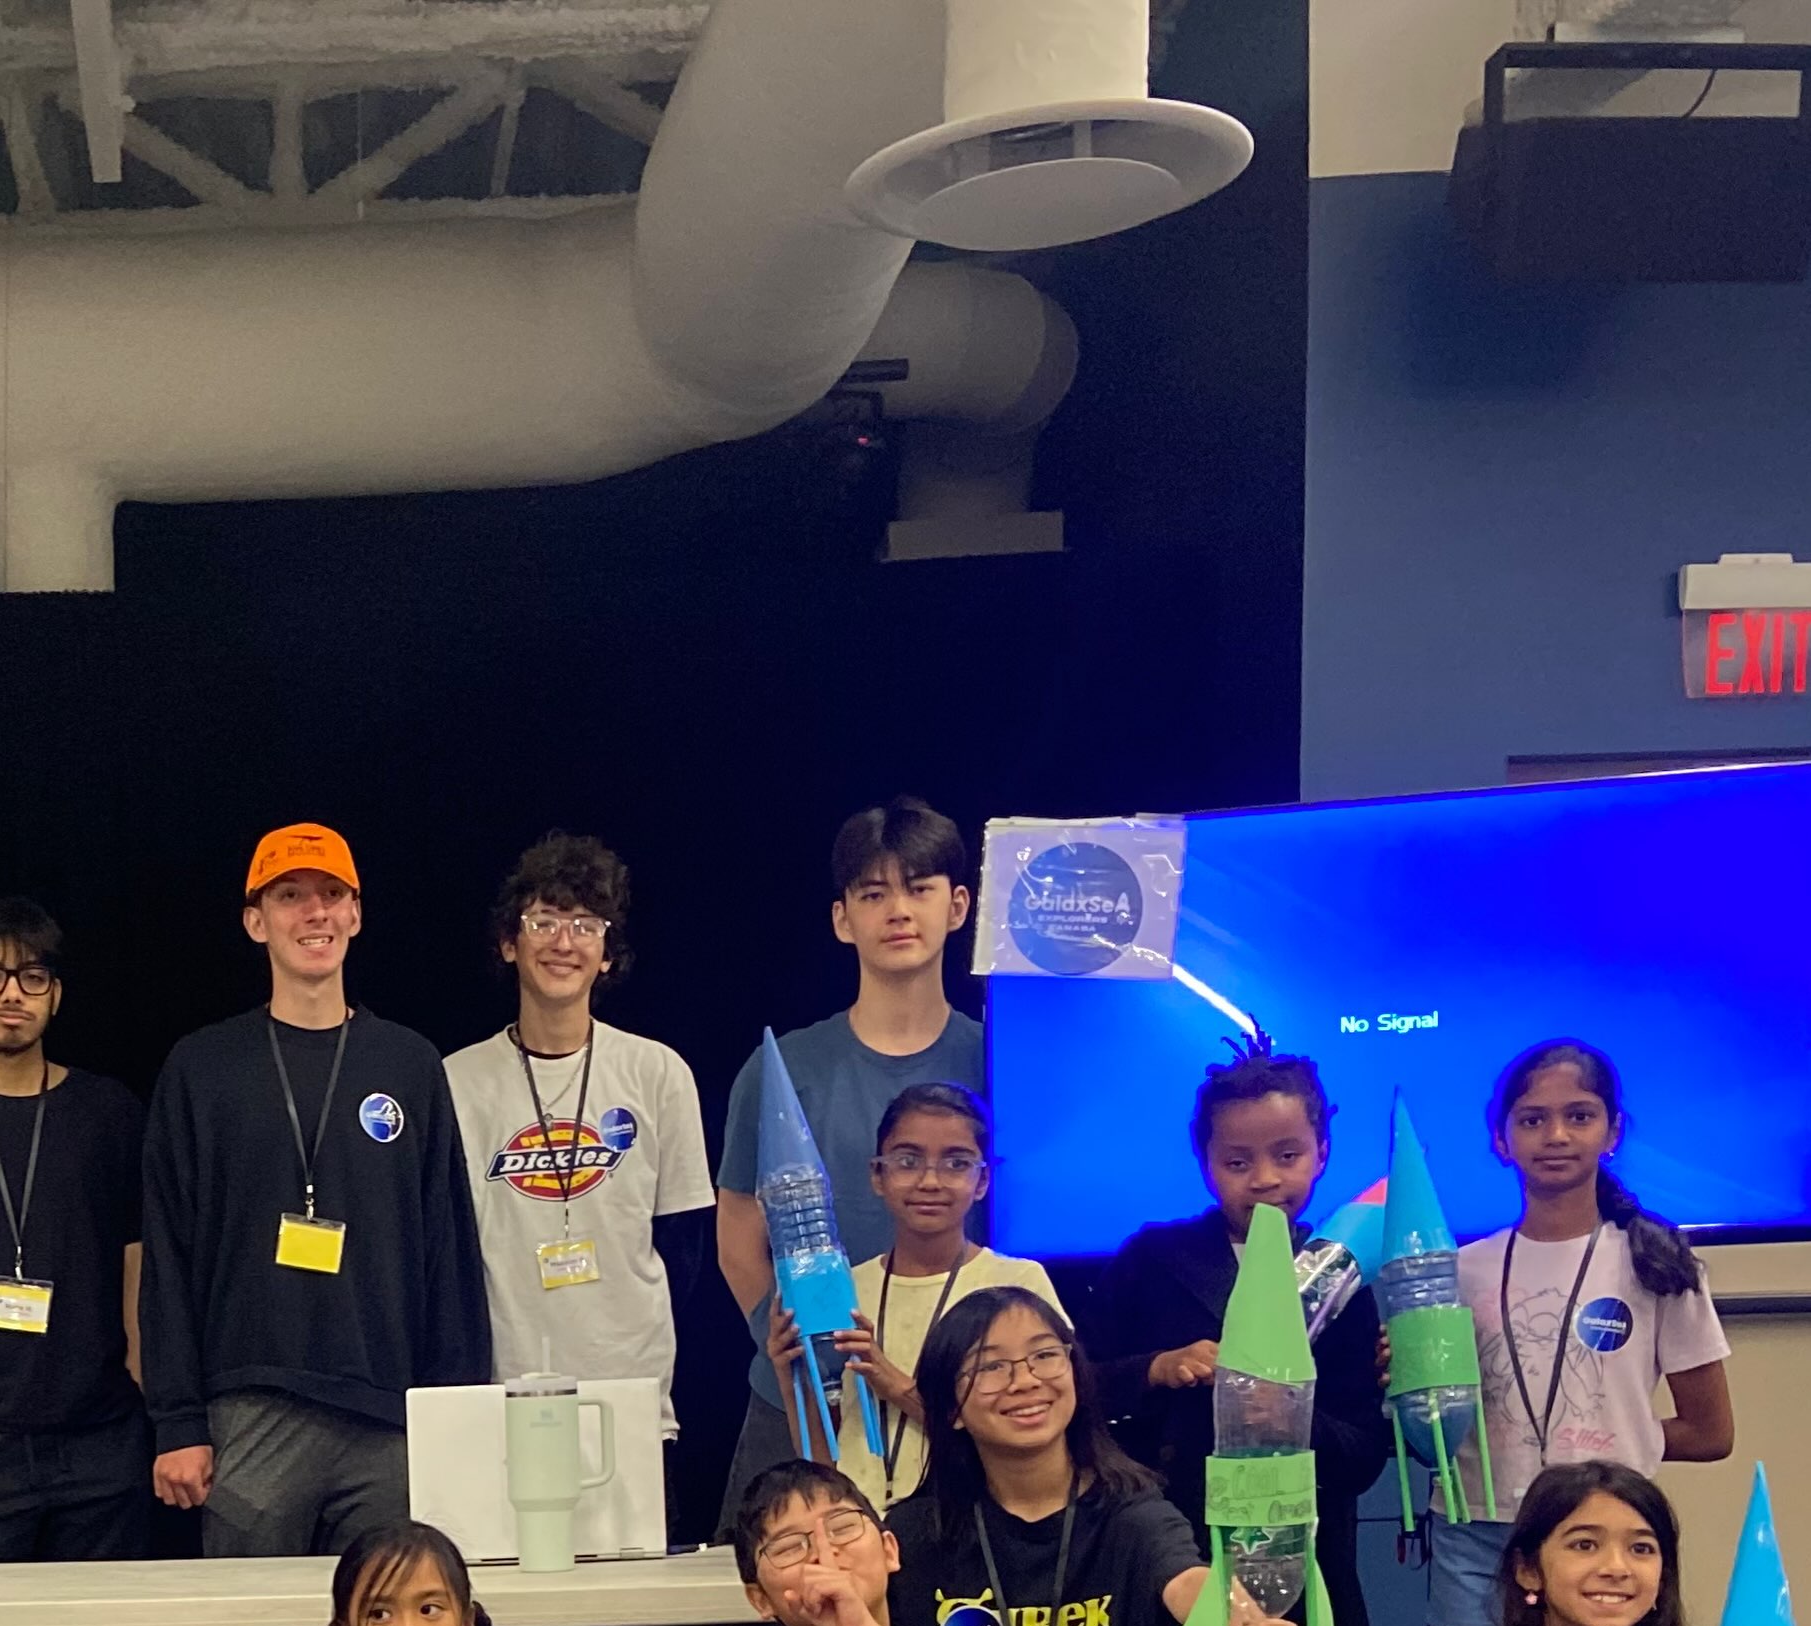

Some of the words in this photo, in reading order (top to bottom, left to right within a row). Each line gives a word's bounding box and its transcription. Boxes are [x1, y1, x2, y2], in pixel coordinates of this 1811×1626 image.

[1705, 611, 1811, 694] EXIT
[1340, 1016, 1369, 1033] No
[1377, 1010, 1438, 1034] Signal
[499, 1150, 613, 1174] Dickies
